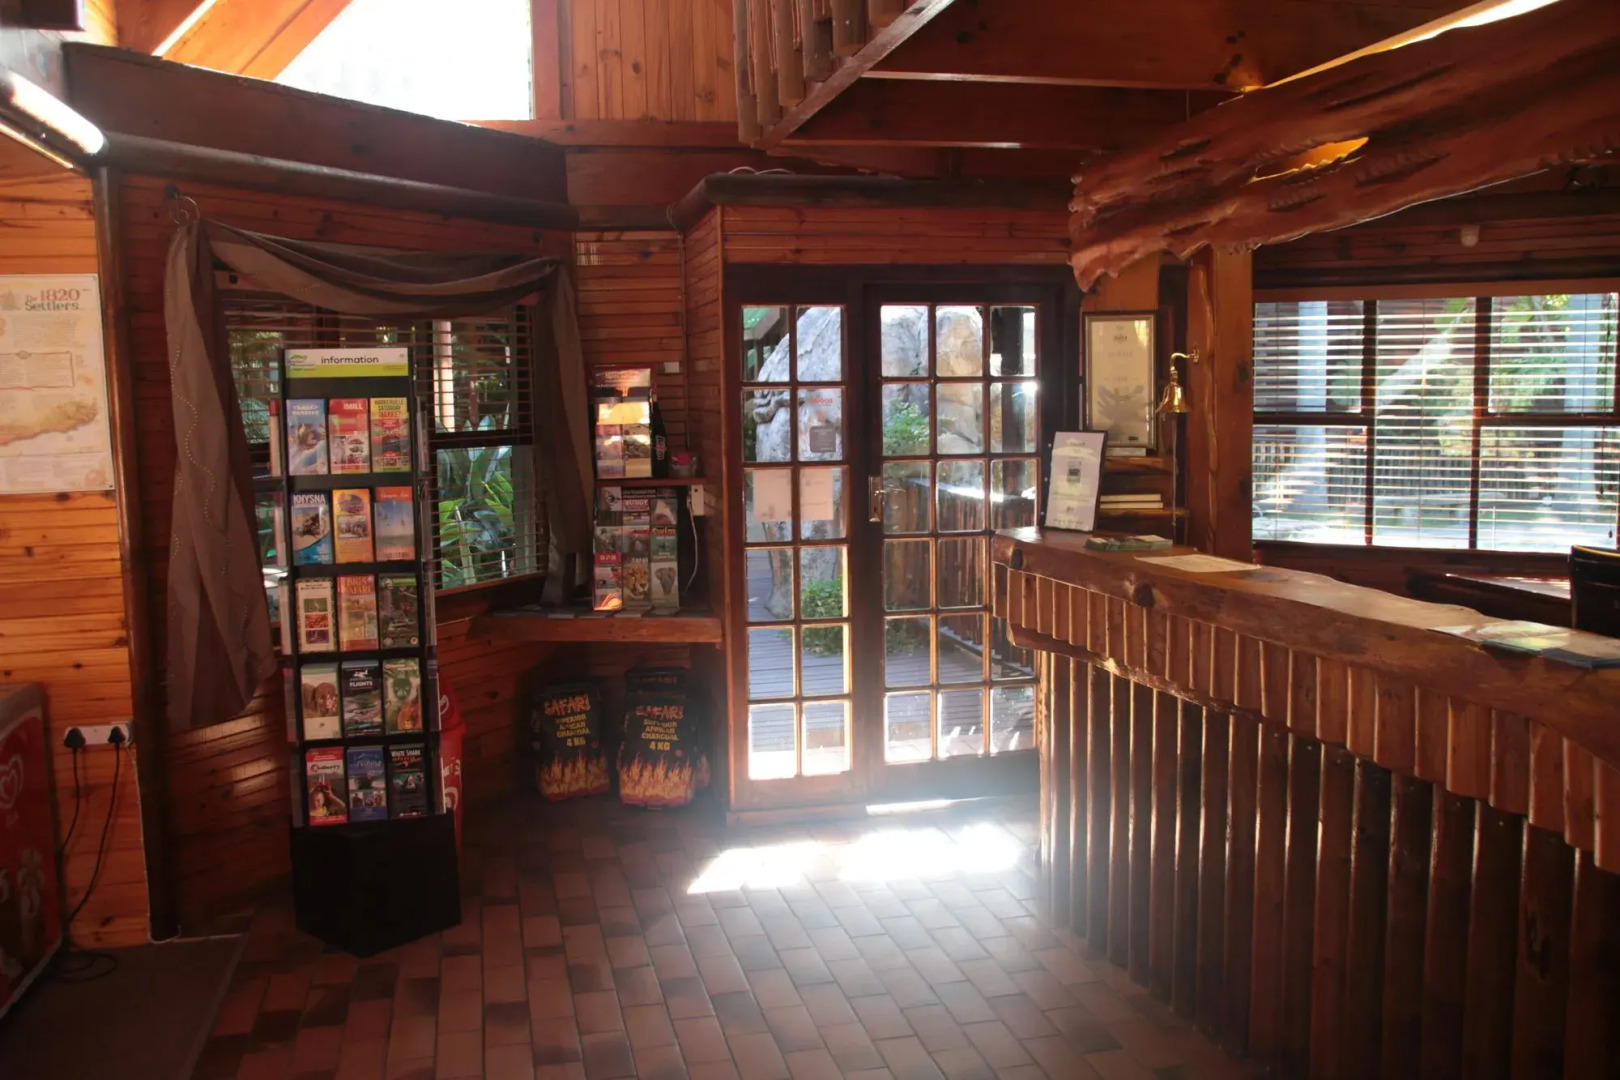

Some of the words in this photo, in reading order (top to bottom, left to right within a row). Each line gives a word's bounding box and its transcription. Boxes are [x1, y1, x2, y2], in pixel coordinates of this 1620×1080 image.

[39, 288, 81, 301] 1820
[24, 300, 80, 312] Settlers
[321, 354, 379, 364] information
[293, 494, 326, 505] KNYSNA
[349, 680, 373, 688] FLIGHTS
[544, 694, 591, 715] SAFARI
[635, 705, 684, 720] SAFARI
[641, 732, 679, 741] CHARCOAL
[649, 741, 656, 750] 4
[657, 742, 671, 751] KG
